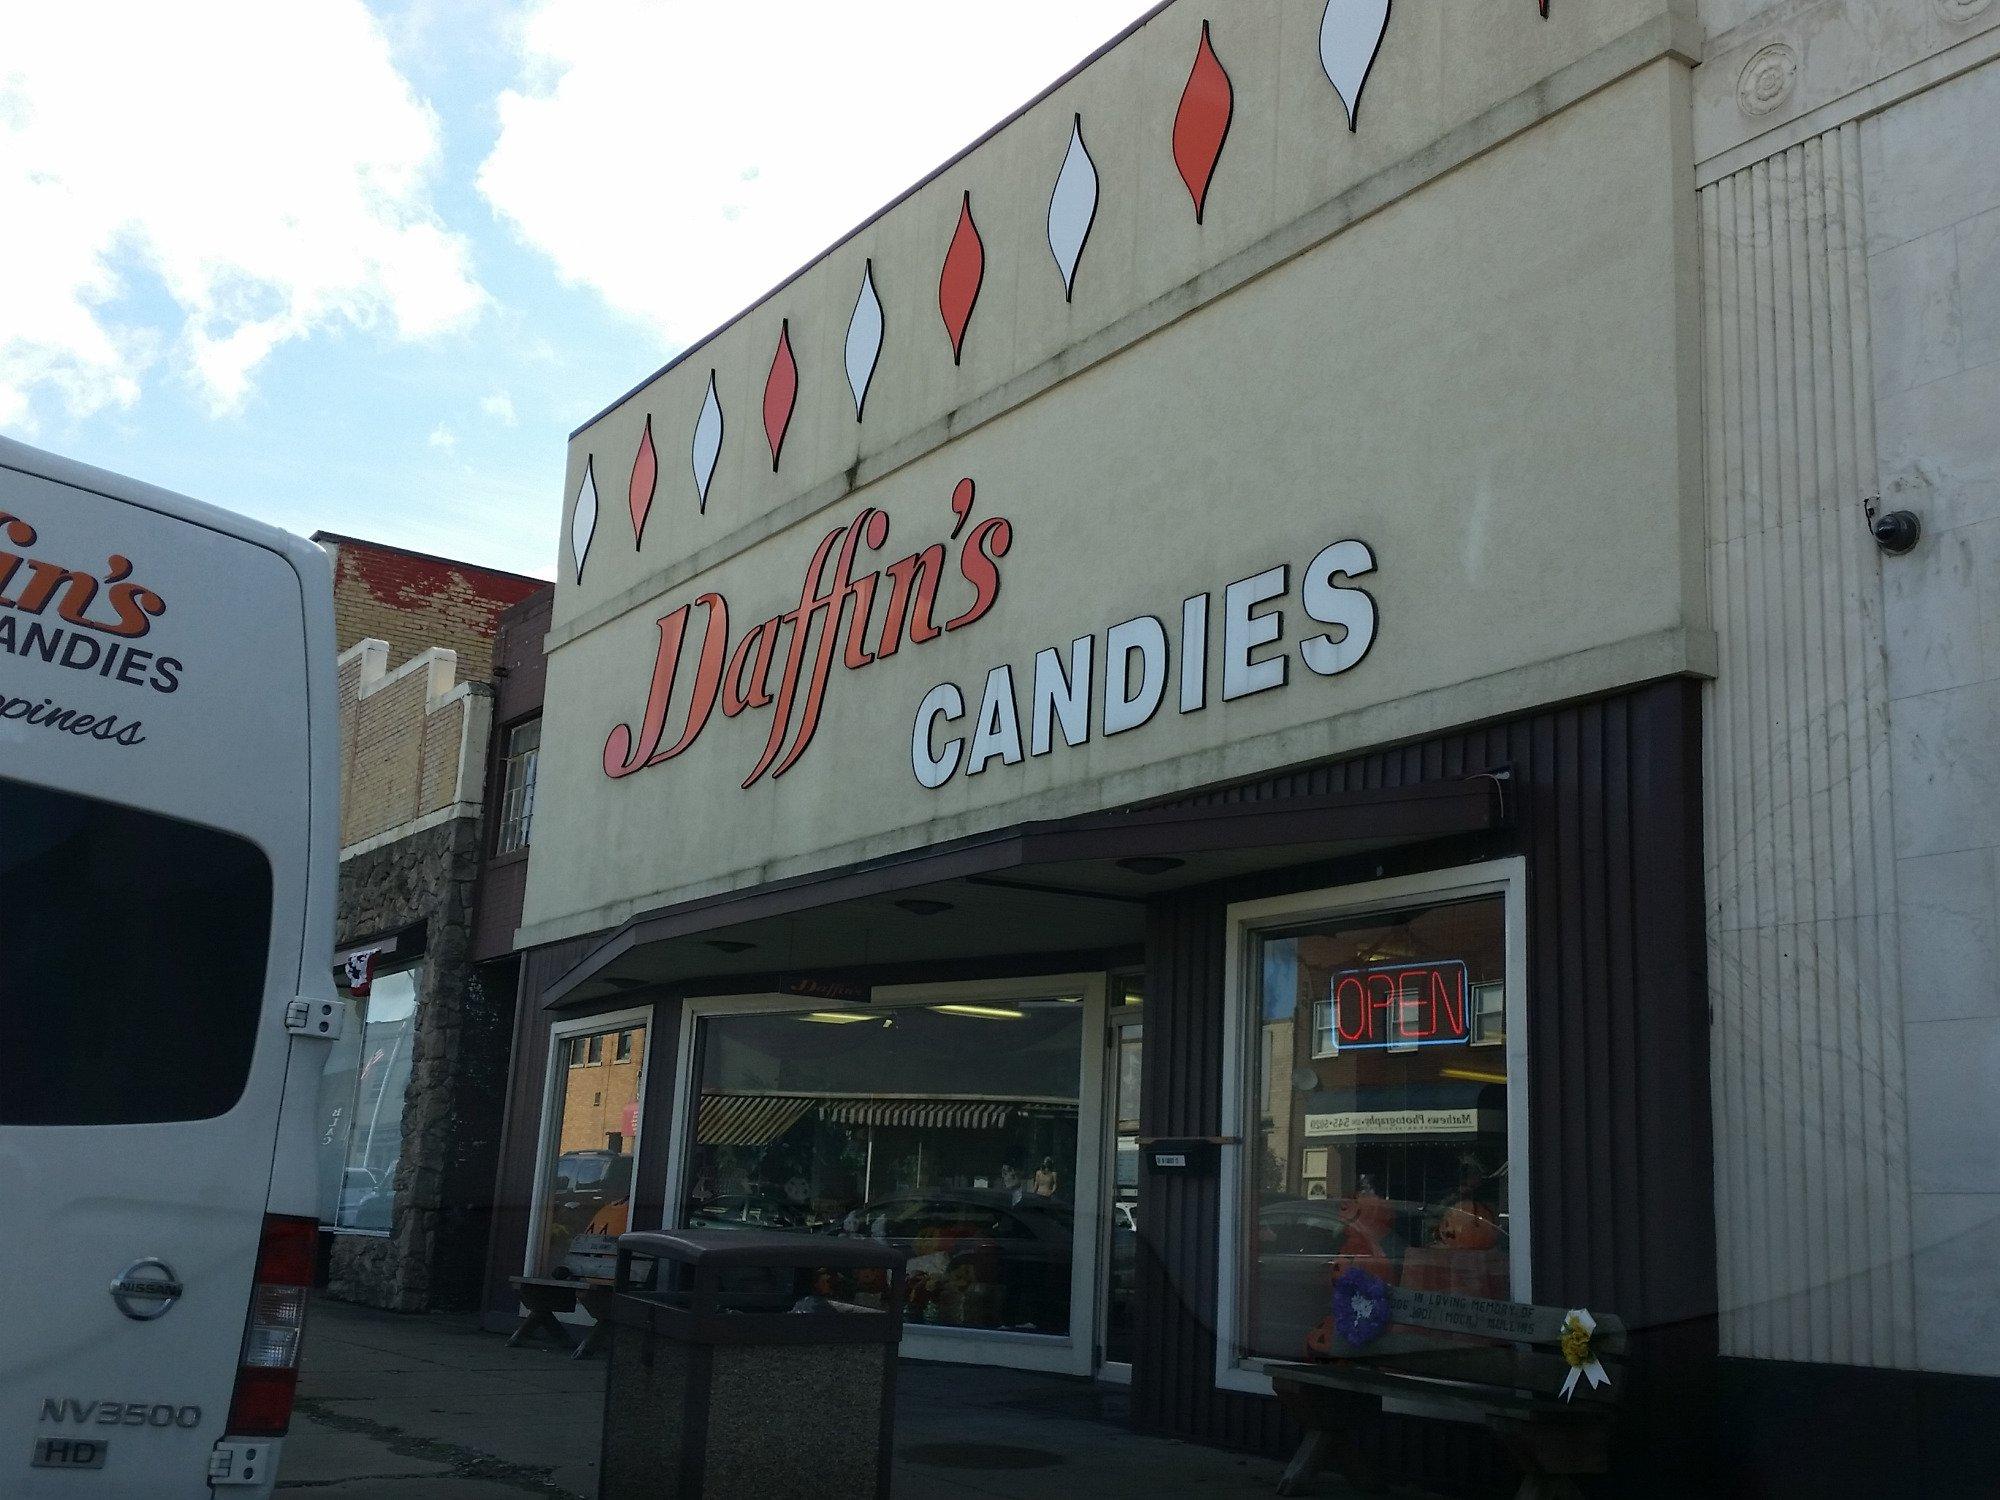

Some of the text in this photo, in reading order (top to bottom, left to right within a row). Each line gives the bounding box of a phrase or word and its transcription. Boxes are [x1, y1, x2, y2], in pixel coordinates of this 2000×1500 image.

[602, 477, 1013, 790] Daffin's
[911, 538, 1378, 790] CANDIES
[1336, 970, 1463, 1041] OPEN
[120, 1281, 178, 1296] NISSAN
[1428, 1293, 1466, 1309] LOVING
[1471, 1300, 1514, 1316] MEMORY
[39, 1398, 202, 1429] NV3500
[44, 1440, 97, 1464] HD
